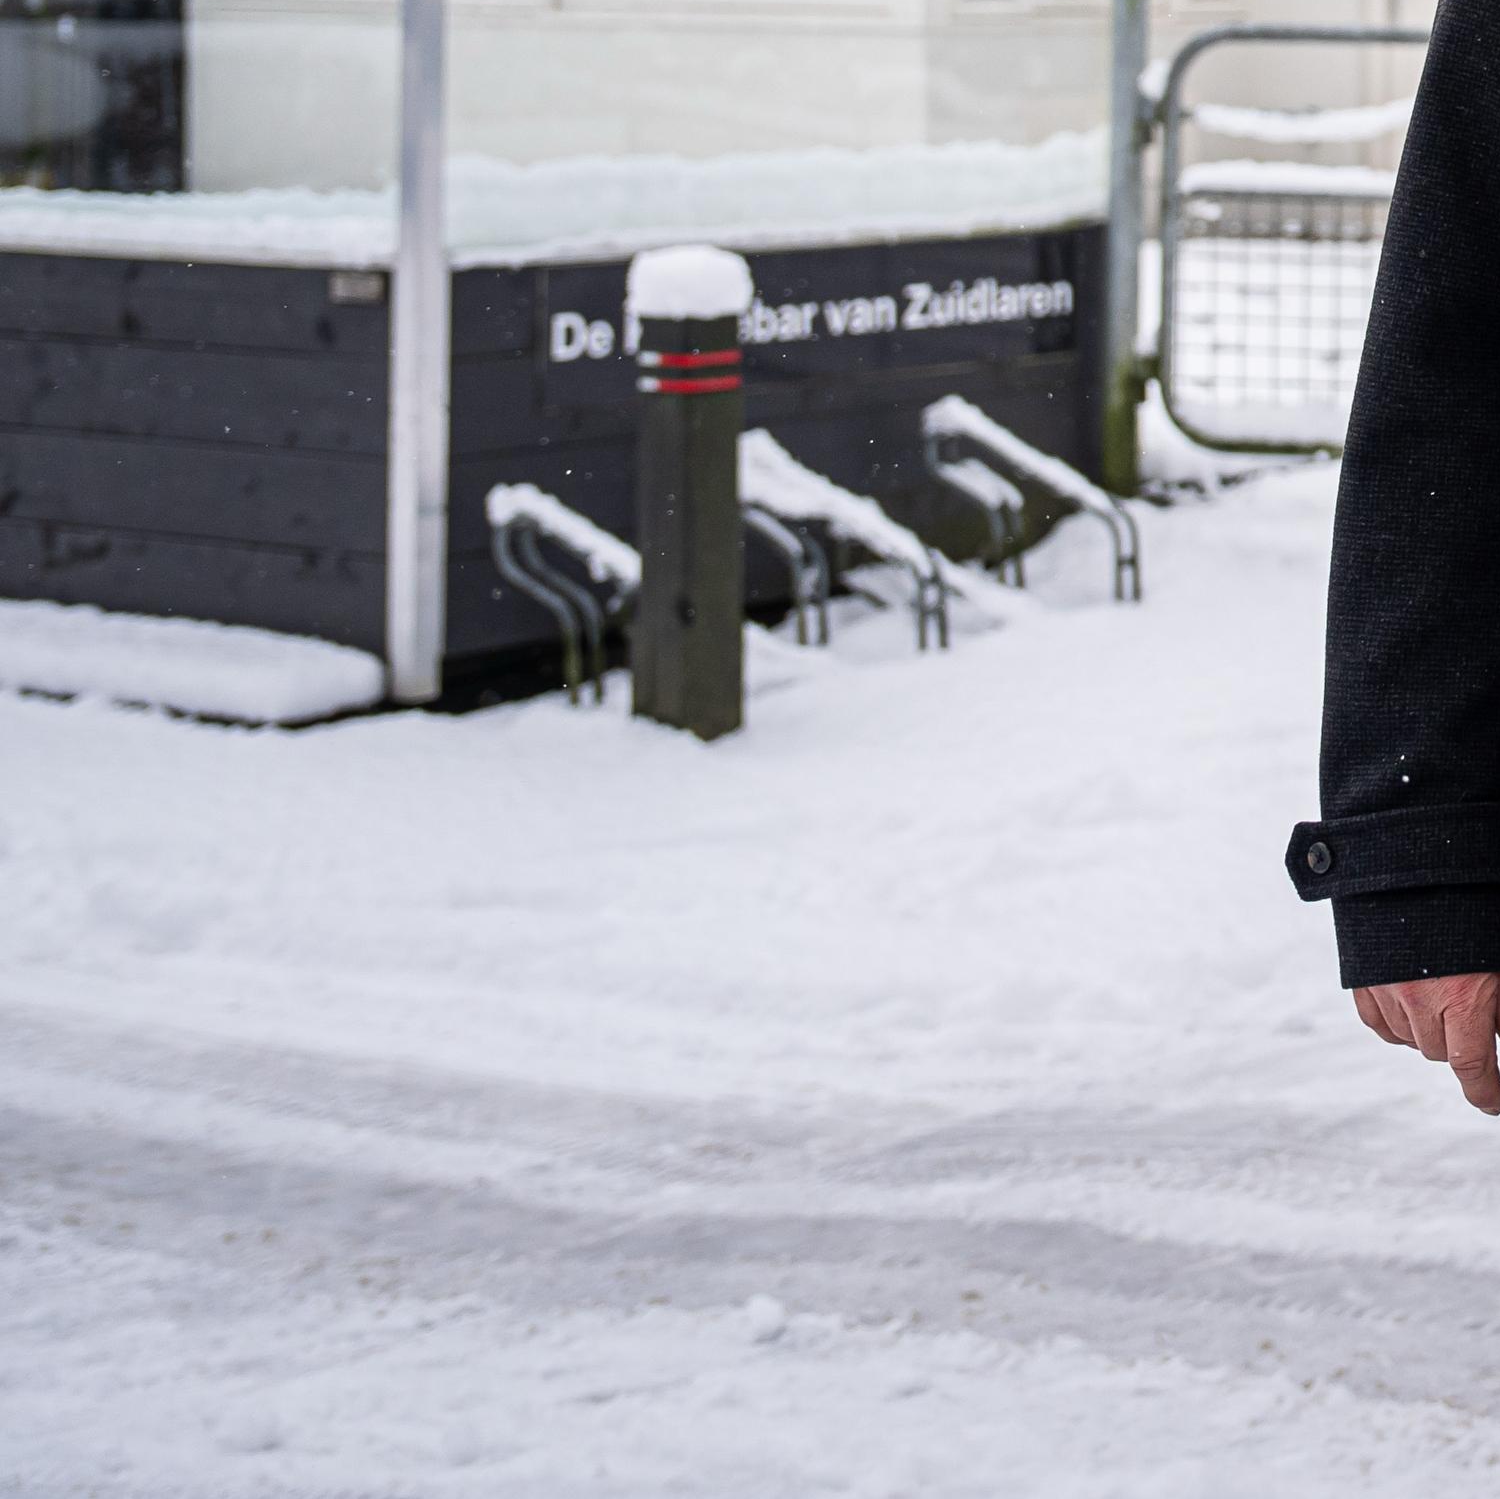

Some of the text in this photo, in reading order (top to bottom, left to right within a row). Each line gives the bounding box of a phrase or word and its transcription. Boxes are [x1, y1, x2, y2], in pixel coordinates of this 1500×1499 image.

[551, 310, 616, 362] De
[822, 296, 898, 336] van
[902, 276, 1075, 331] Zuidlaren
